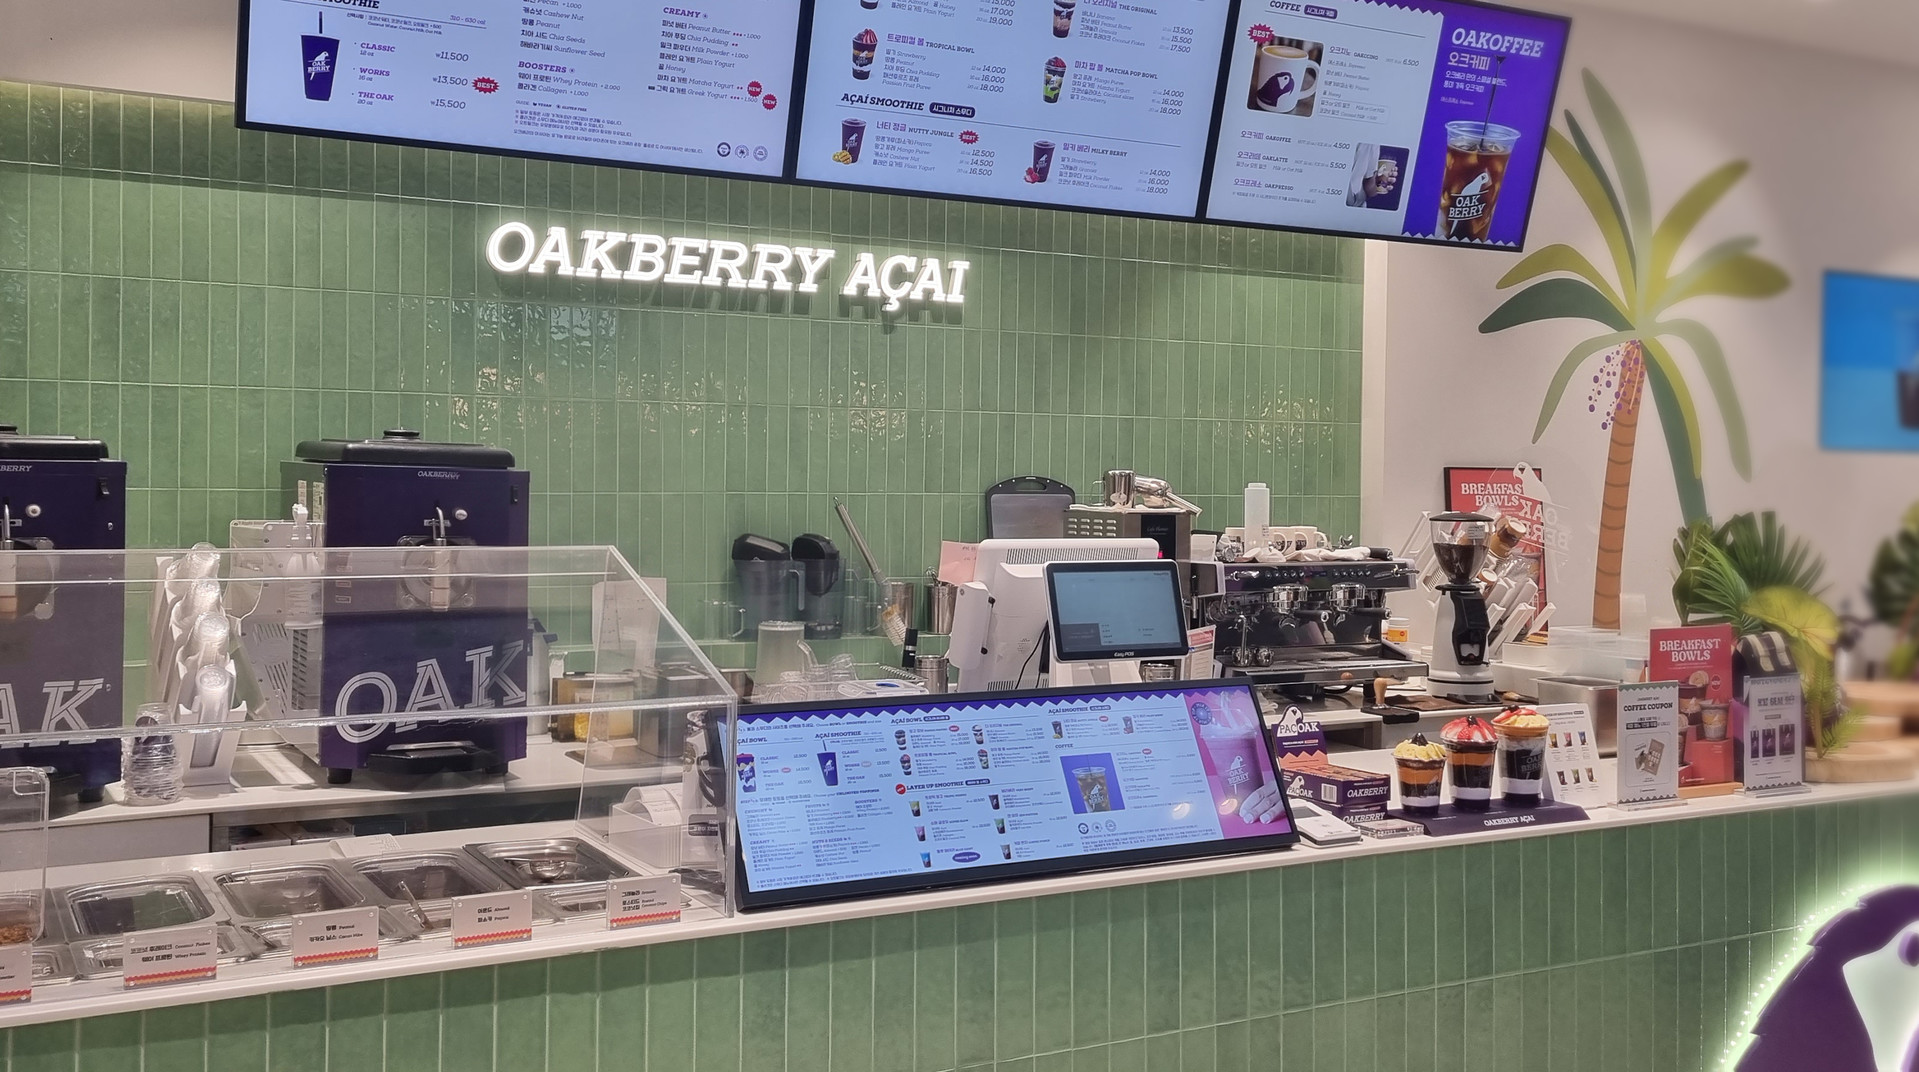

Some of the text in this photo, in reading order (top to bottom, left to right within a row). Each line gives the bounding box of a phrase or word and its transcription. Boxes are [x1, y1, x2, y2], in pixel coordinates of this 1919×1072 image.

[991, 7, 1014, 16] 17,000
[1131, 6, 1158, 15] ORIGINAL
[1270, 1, 1301, 12] COFFEE
[523, 6, 542, 15] 캐슈넛
[543, 10, 570, 18] Cashew
[663, 7, 700, 18] CREAMY
[536, 20, 560, 29] Peanut
[989, 17, 1013, 26] 19,000
[675, 22, 687, 30] 버터
[688, 23, 710, 32] Peanut
[712, 27, 731, 35] Butter
[1173, 26, 1194, 35] 13,500
[1252, 29, 1270, 38] BEST
[521, 29, 534, 37] 치아
[535, 31, 548, 39] 시드
[566, 35, 586, 44] Seeds
[687, 34, 701, 42] Chia
[702, 36, 729, 47] Pudding
[1171, 36, 1192, 44] 15,500
[360, 42, 395, 52] CLASSIC
[887, 33, 975, 54] 트로피컬 TROPICAL BOWL
[1451, 28, 1544, 58] OAKOFFEE
[553, 45, 606, 58] Sunflower Seed
[673, 43, 691, 52] 파우더
[692, 45, 705, 53] Milk
[706, 47, 730, 56] Powder
[1170, 44, 1191, 53] 17,500
[897, 50, 926, 60] Strawberry
[660, 52, 735, 69] 플레인 요거트 Plain Yogurt
[1448, 51, 1491, 71] 오크커피
[360, 67, 390, 76] WORKS
[518, 61, 567, 73] BOOSTERS
[665, 64, 686, 74] Honey
[918, 65, 1006, 78] Pudding 14,000
[1105, 67, 1129, 76] MATCHA
[981, 75, 1005, 83] 16,000
[1446, 70, 1465, 80] 오크베리
[477, 81, 495, 89] BEST
[552, 76, 598, 88] Whey Protein
[670, 76, 688, 84] 요거트
[688, 78, 712, 87] Matcha
[713, 81, 734, 90] Yogurt
[518, 83, 567, 95] 콜라겐 Collagen
[656, 85, 728, 100] 그릭 요거트 Greek Yogurt
[980, 84, 1003, 93] 18,000
[1465, 84, 1484, 92] 오크커피
[376, 93, 394, 101] OAK
[1163, 89, 1184, 98] 14,000
[841, 93, 924, 111] AÇAÍ SMOOTHIE
[1161, 98, 1183, 106] 16,000
[1160, 107, 1181, 115] 18,000
[877, 122, 891, 130] 너티
[909, 127, 929, 135] NUTTY
[929, 129, 954, 138] JUNGLE
[1266, 135, 1292, 143] OAKOFFEE
[971, 149, 995, 158] 12,500
[1077, 145, 1090, 153] 베리
[1091, 147, 1108, 155] MILKY
[970, 158, 994, 167] 14,500
[1262, 155, 1288, 163] OAKLATTE
[969, 168, 992, 176] 16,500
[1149, 169, 1171, 177] 14,000
[1148, 178, 1169, 186] 16,000
[1146, 186, 1168, 194] 18,000
[1456, 195, 1480, 207] OAK
[1449, 203, 1486, 218] BERRY
[486, 221, 971, 312] OAKBERRY AÇAI
[418, 471, 460, 480] OAKBERRY
[1461, 483, 1524, 495] BREAKFAS
[1475, 495, 1520, 506] BOWLS
[1659, 639, 1721, 652] BREAKFAST
[1671, 650, 1710, 662] BOWLS
[335, 641, 526, 743] OAK
[1624, 702, 1673, 712] COFFEE COUPON
[1280, 723, 1319, 734] PACOAK
[1230, 768, 1243, 776] OAK
[1228, 773, 1249, 785] BERRY
[1288, 786, 1313, 798] PACOAK
[1348, 787, 1388, 798] OAKBERRY
[1343, 812, 1385, 823] OAKBERRY
[1484, 814, 1535, 826] OAKBERRY AÇAI
